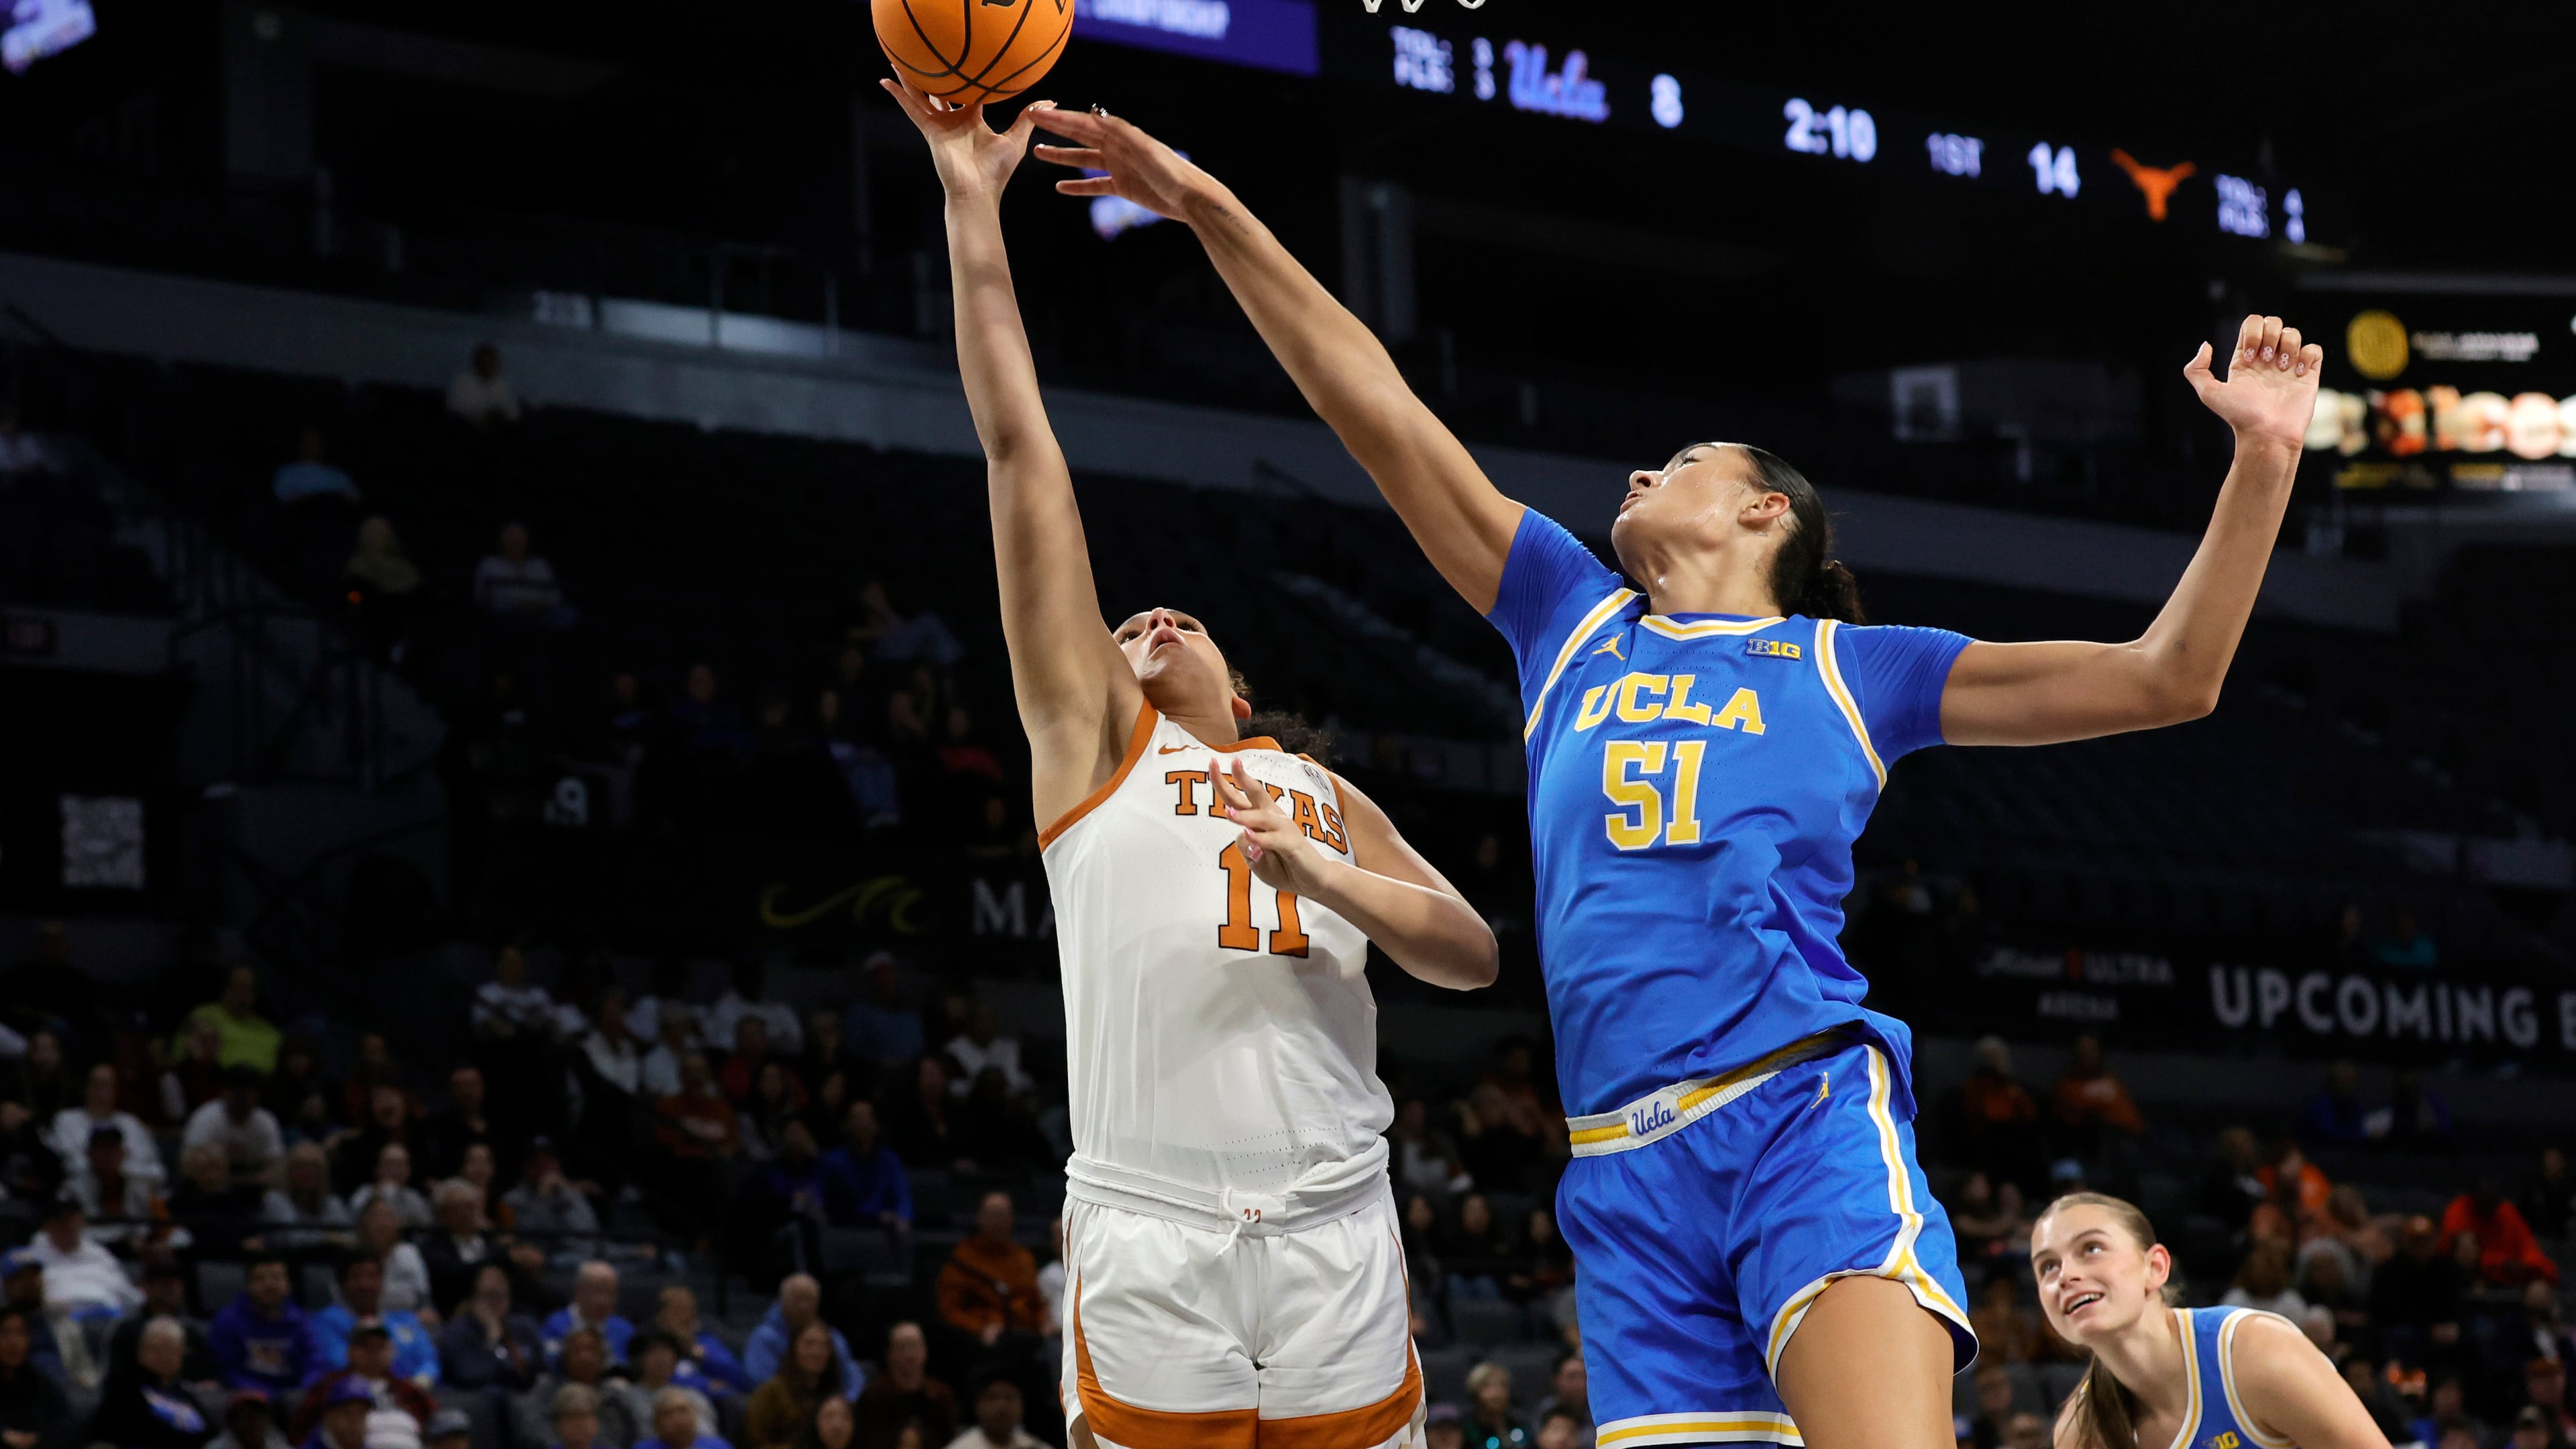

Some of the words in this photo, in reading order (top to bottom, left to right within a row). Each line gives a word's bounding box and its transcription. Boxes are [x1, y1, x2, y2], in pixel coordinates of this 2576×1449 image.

[1651, 73, 1684, 128] 8
[1783, 98, 1877, 163] 2:10
[2028, 141, 2080, 199] 14
[1574, 672, 1766, 736] UCLA
[1602, 740, 1707, 852] 51
[1218, 840, 1309, 959] 11
[2208, 962, 2541, 1051] UPCOMING
[1631, 1100, 1676, 1136] Ucla
